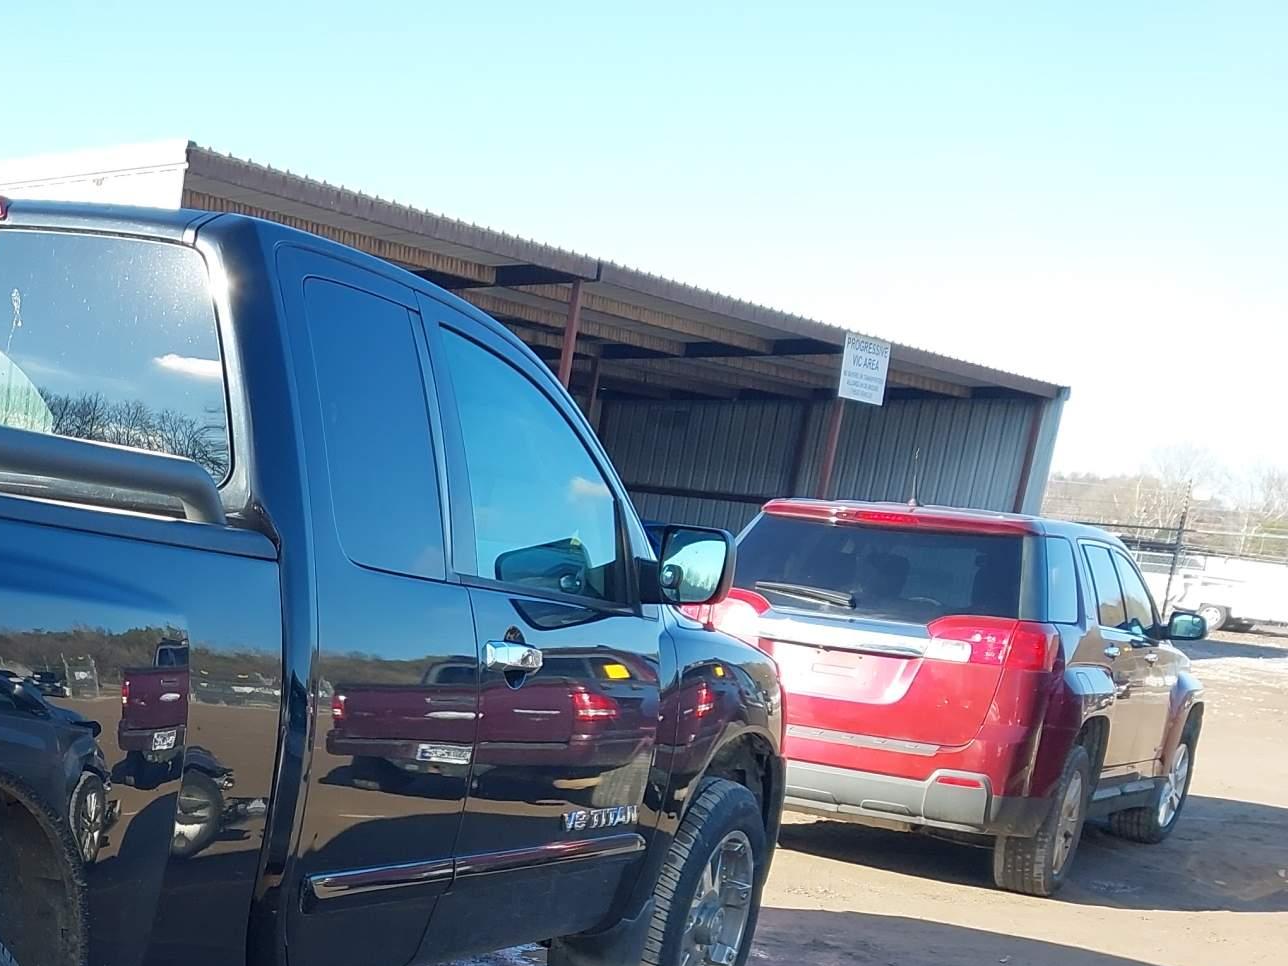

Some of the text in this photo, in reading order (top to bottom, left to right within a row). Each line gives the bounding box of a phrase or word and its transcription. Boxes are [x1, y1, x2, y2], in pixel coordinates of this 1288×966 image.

[846, 336, 889, 359] PROGRESSIVE
[863, 358, 880, 371] AREA
[590, 805, 638, 828] TITAN
